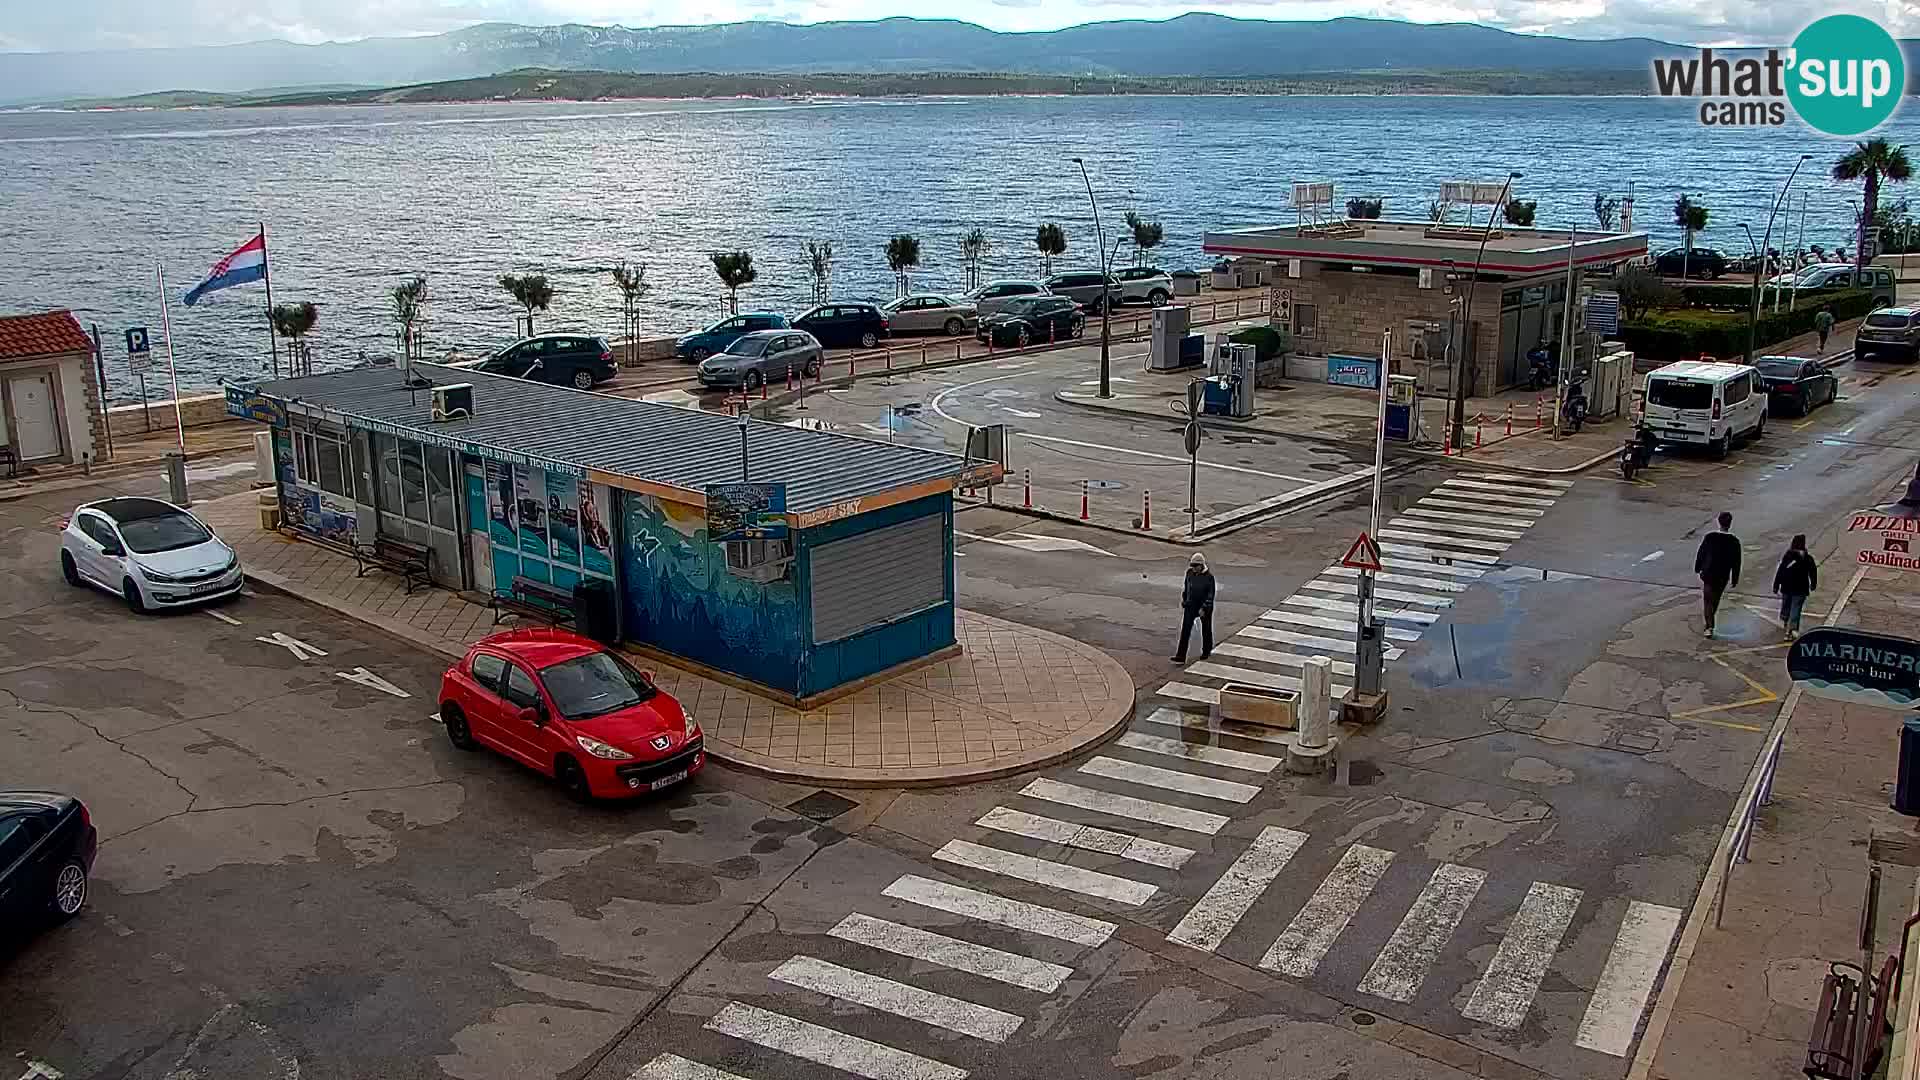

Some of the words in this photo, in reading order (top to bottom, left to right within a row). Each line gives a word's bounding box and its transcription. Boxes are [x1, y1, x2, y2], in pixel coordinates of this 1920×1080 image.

[132, 331, 143, 350] P
[396, 428, 437, 446] AUTOBUSNA
[437, 437, 468, 452] POSTAJA
[478, 446, 494, 459] BUS
[495, 451, 527, 465] STATION
[529, 457, 555, 471] TICKET
[555, 463, 584, 478] OFFICE
[1848, 516, 1920, 533] PIZZE
[1828, 663, 1865, 674] caffe
[1869, 666, 1896, 680] bar
